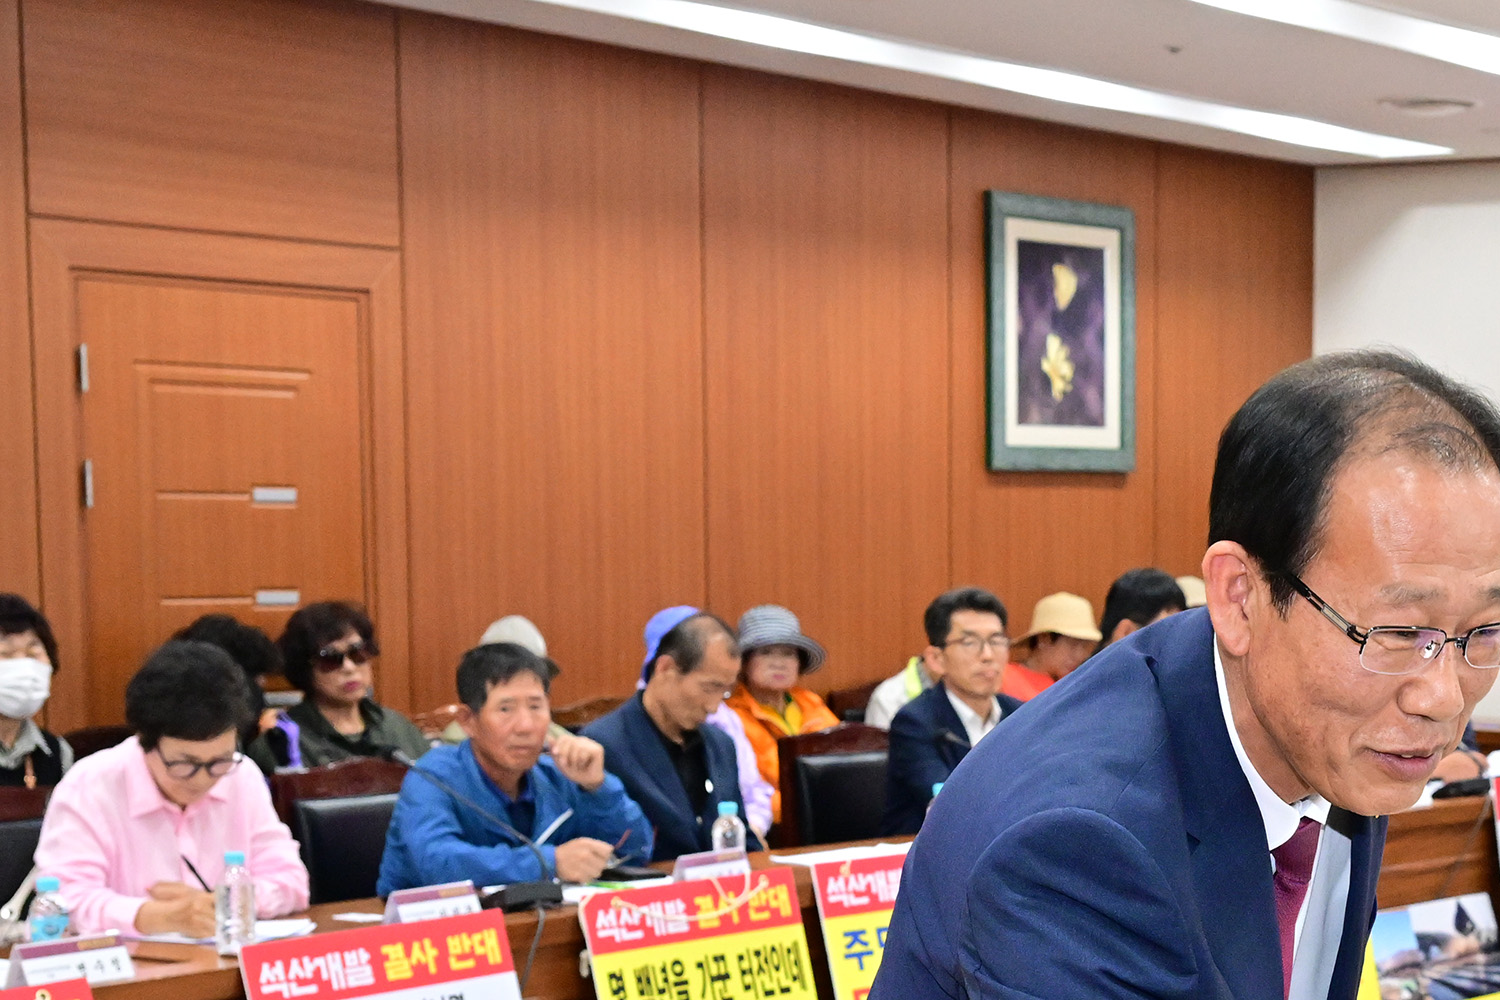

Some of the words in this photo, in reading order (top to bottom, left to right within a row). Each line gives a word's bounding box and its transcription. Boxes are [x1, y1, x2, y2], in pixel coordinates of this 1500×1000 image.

[596, 899, 690, 943] 석산개발
[694, 891, 739, 929] 결사
[749, 884, 792, 921] 반대
[258, 947, 376, 999] 석산개발
[381, 938, 438, 982] 결사
[446, 928, 503, 971] 반대
[737, 940, 808, 1000] 터전인데
[843, 927, 888, 971] 주
